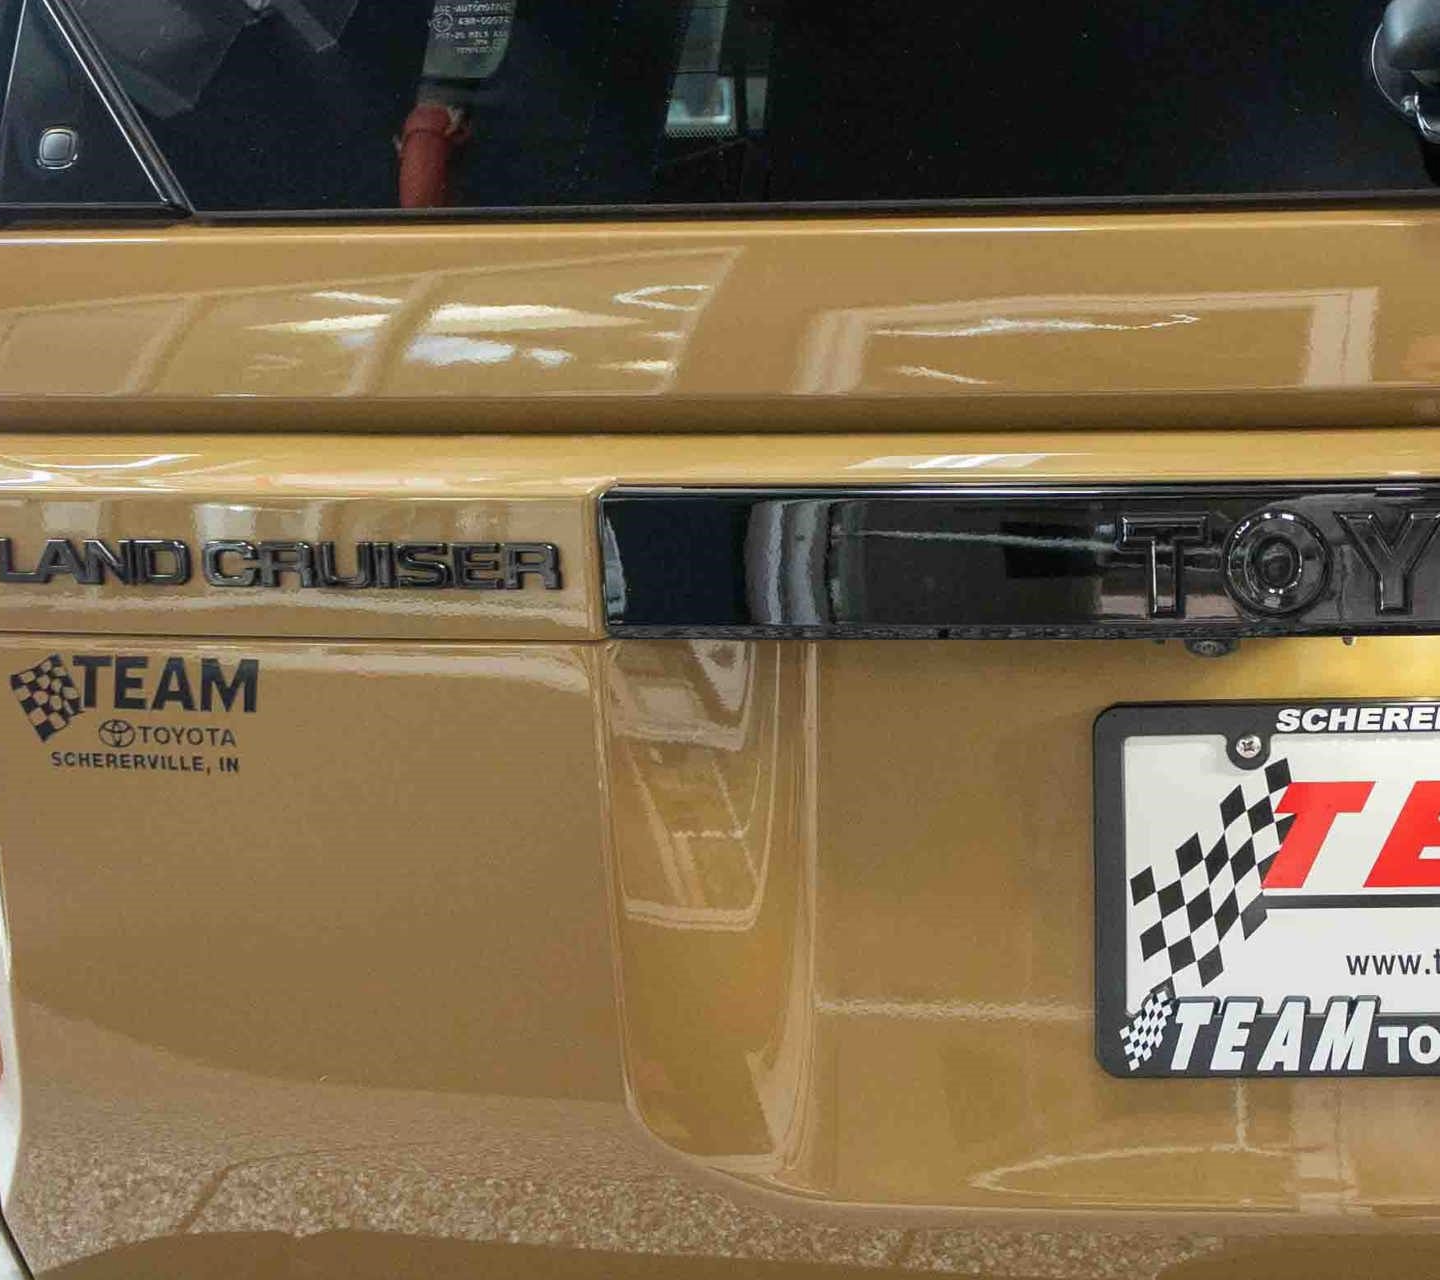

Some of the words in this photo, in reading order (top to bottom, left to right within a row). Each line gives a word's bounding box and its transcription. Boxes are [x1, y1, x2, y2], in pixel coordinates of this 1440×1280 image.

[202, 538, 565, 592] CRUISER
[72, 655, 260, 714] TEAM
[140, 726, 237, 748] TOYOTA
[51, 751, 212, 776] SCHERERVILLE,
[218, 756, 241, 774] IN
